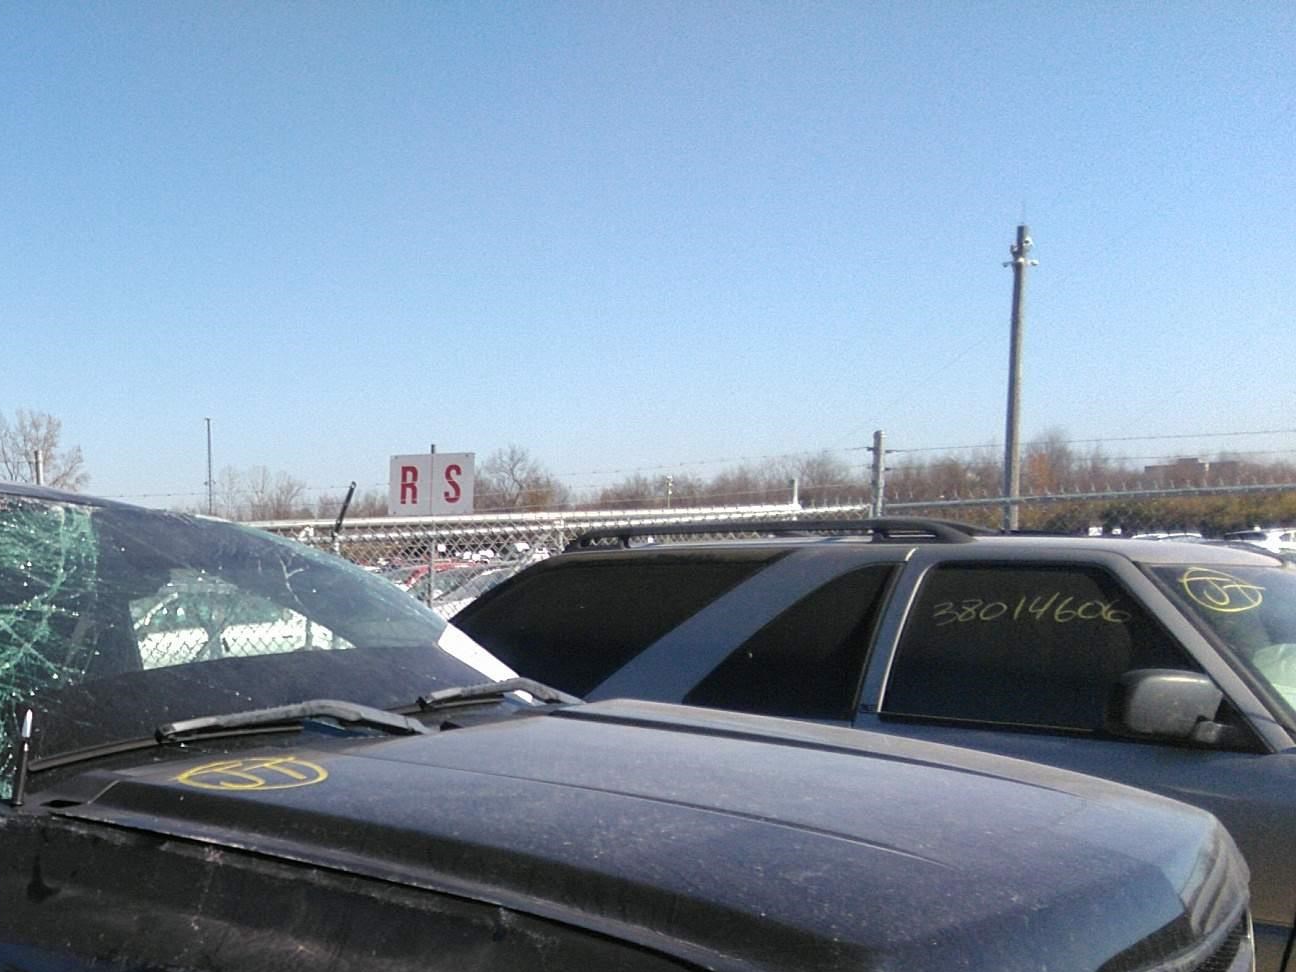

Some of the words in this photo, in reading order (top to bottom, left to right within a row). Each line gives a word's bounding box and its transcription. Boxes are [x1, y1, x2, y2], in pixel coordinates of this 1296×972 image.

[399, 465, 419, 505] R
[444, 464, 462, 504] S
[933, 592, 1132, 626] 38014606
